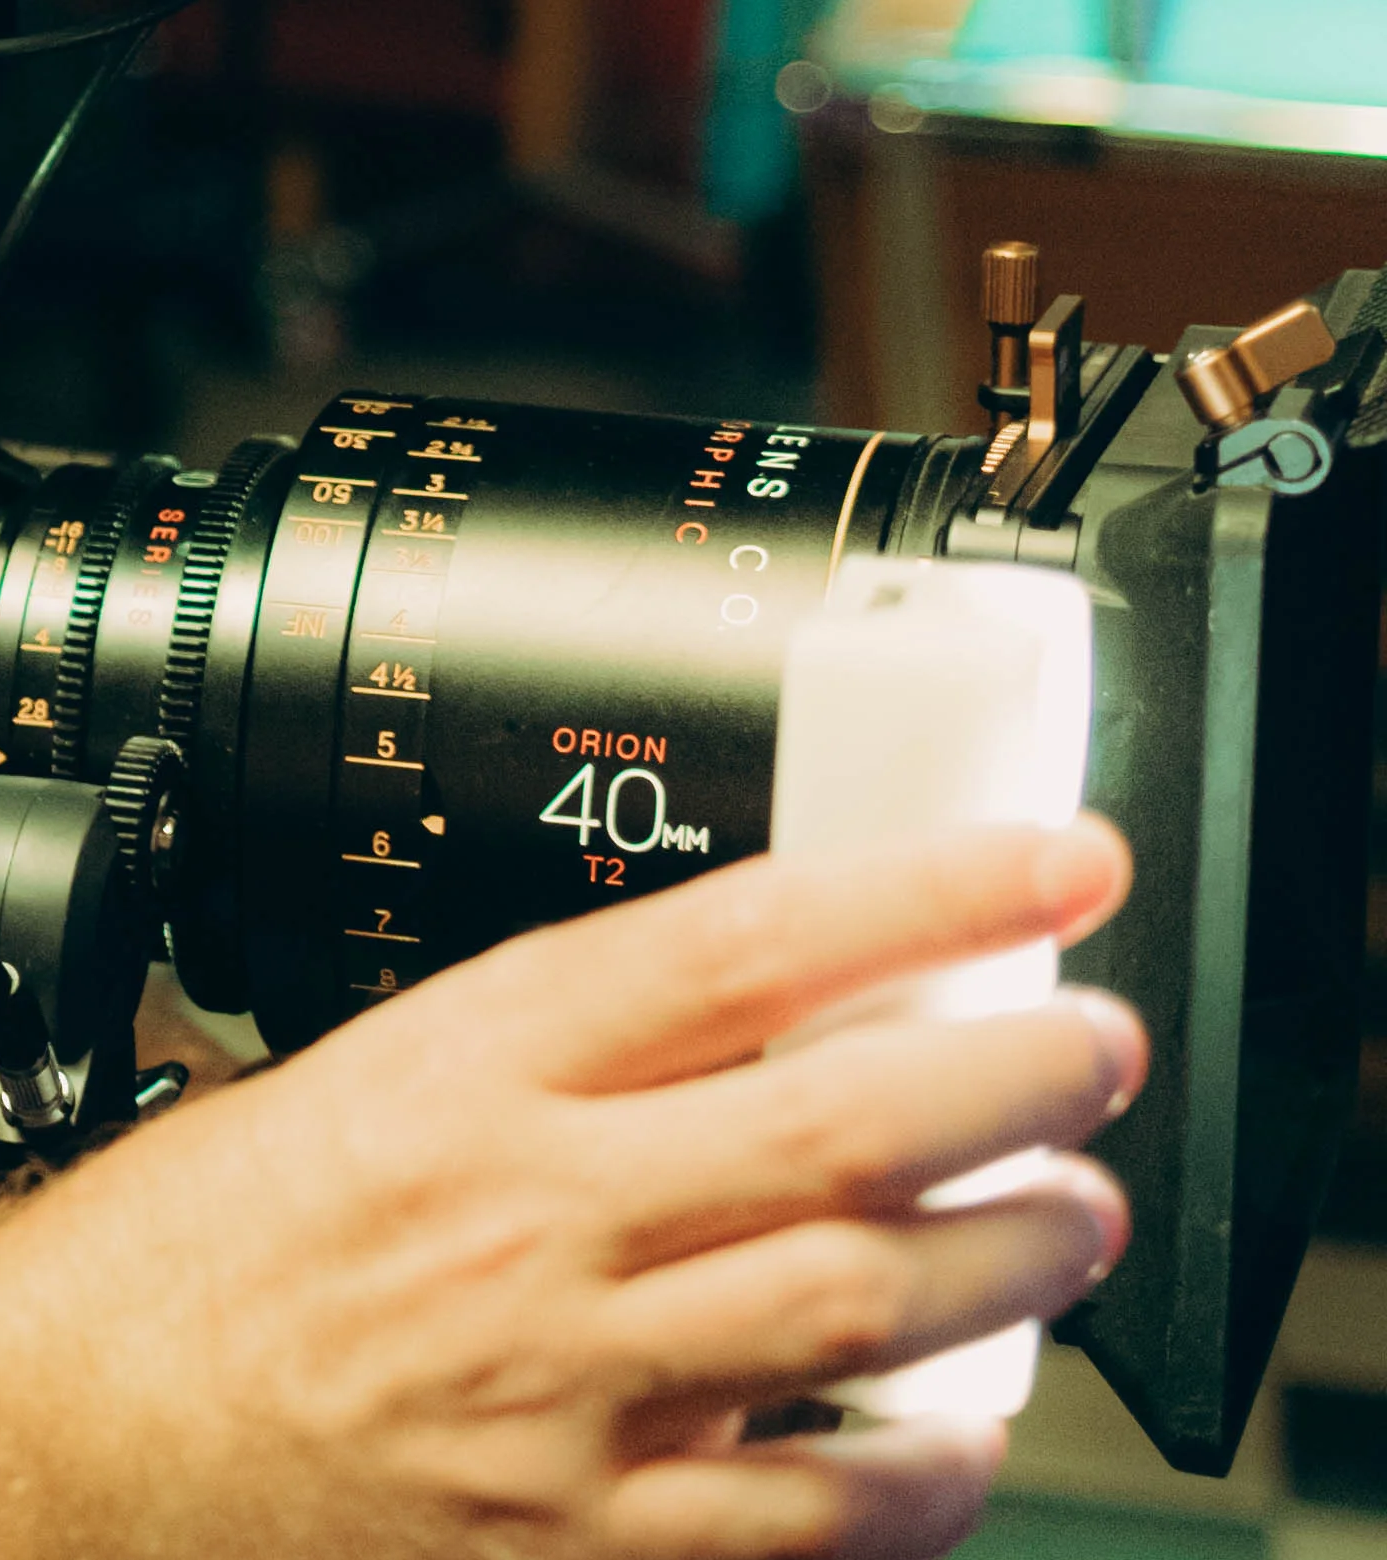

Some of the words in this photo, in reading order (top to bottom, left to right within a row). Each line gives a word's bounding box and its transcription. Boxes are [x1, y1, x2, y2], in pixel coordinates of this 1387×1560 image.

[747, 425, 815, 499] LENS
[312, 481, 355, 505] 50
[426, 474, 447, 492] 3
[128, 507, 186, 626] SERIES
[34, 628, 50, 645] 4
[280, 610, 328, 639] INF
[377, 731, 397, 759] 5
[552, 727, 667, 764] ORION
[372, 831, 391, 857] 6
[583, 854, 626, 886] T2
[374, 909, 392, 933] 7
